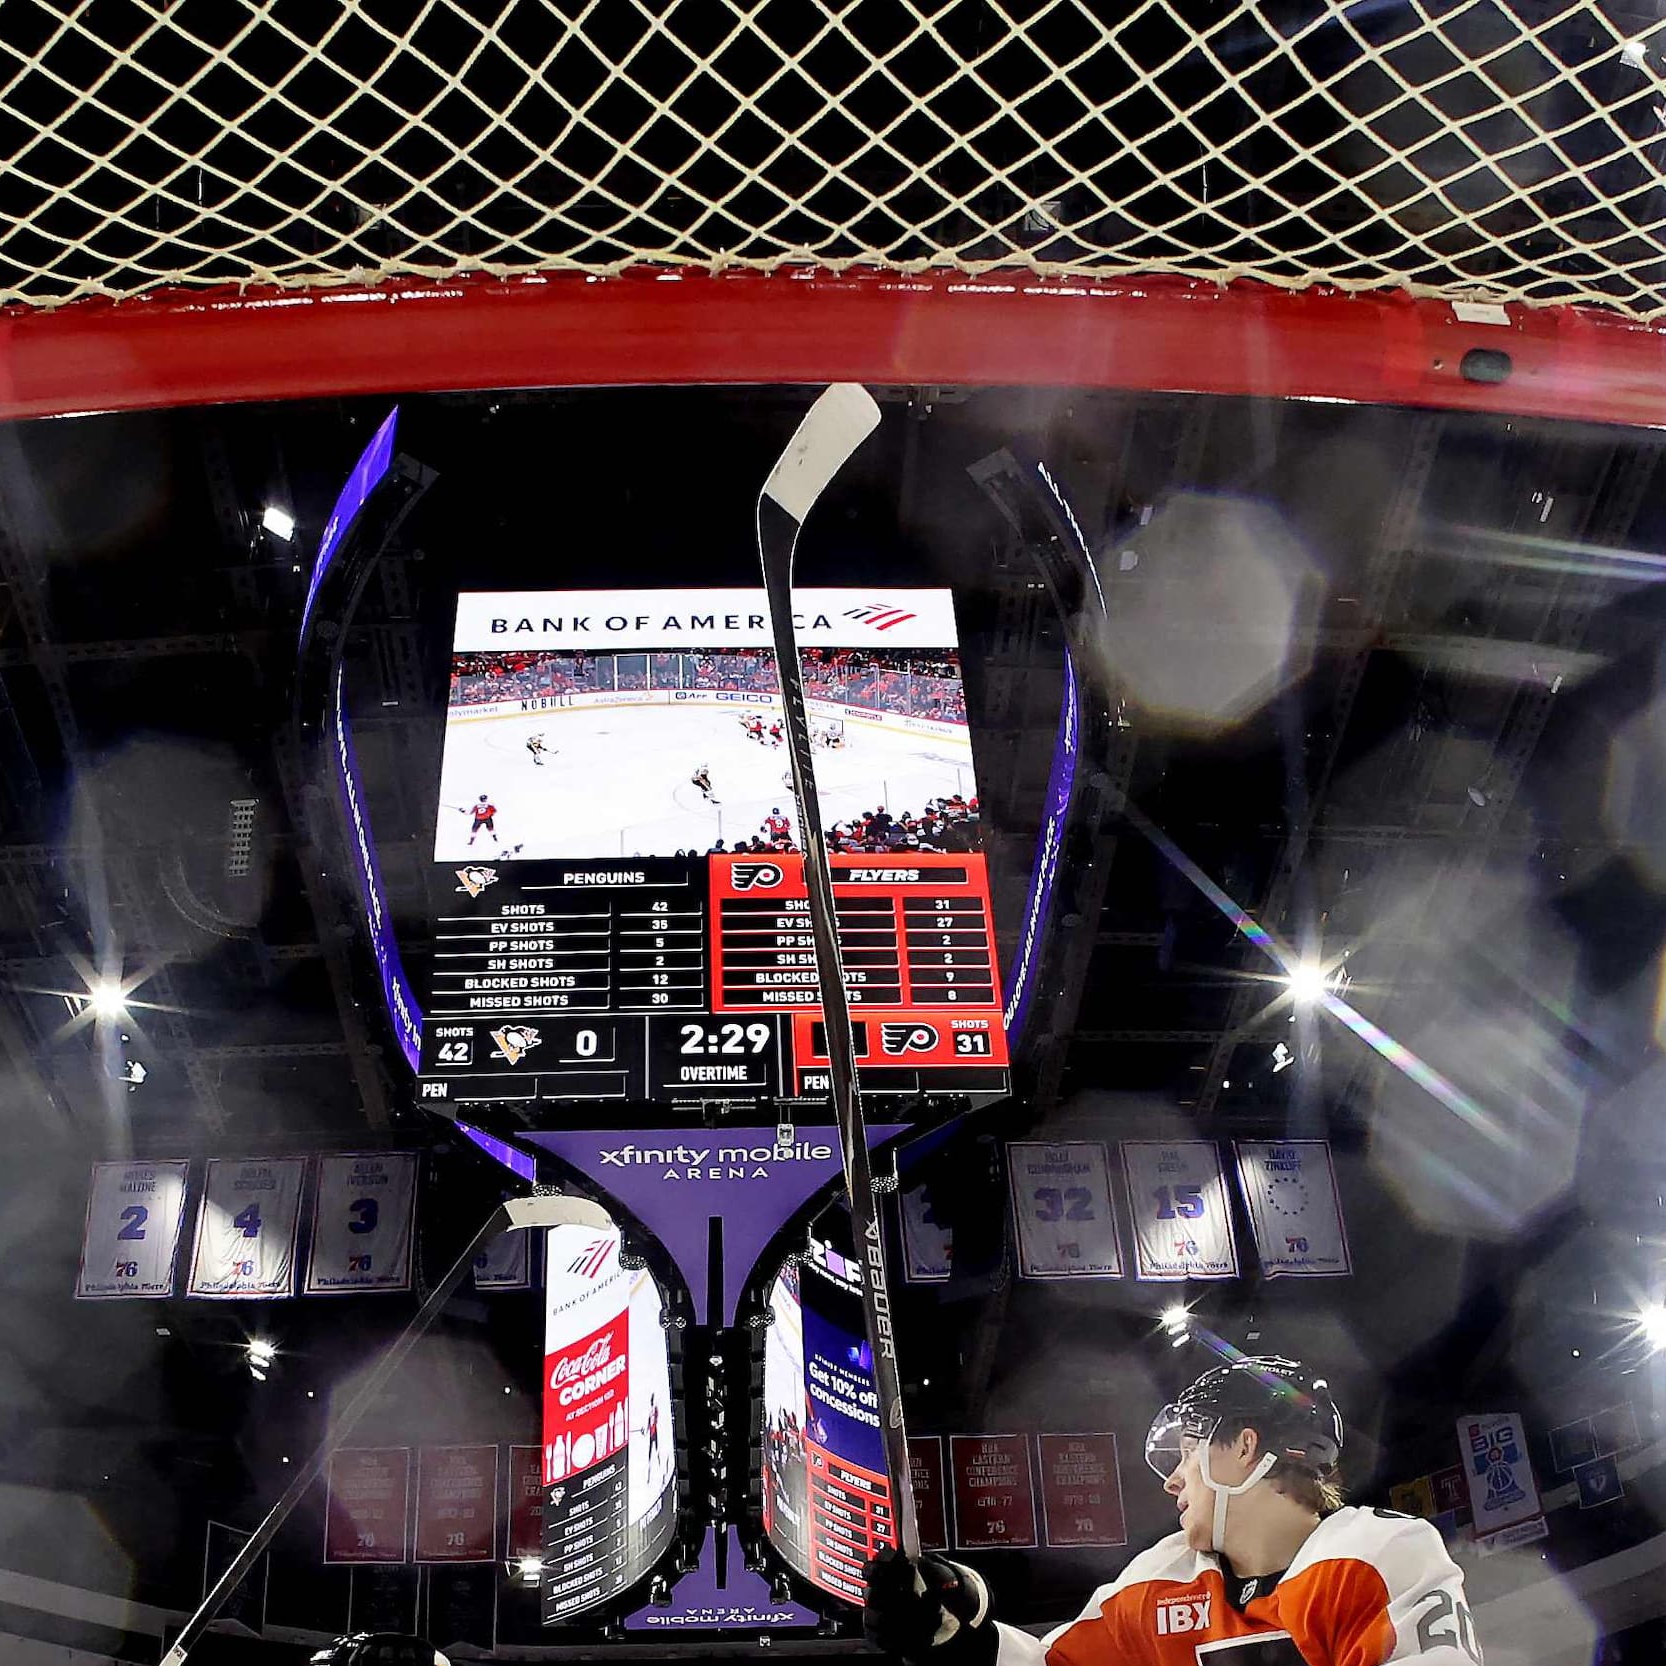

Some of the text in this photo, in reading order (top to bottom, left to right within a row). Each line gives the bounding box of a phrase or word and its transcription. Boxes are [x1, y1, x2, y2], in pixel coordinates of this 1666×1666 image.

[490, 614, 832, 634] BANK OF AMERCA
[521, 695, 573, 711] NOBULL
[716, 693, 772, 703] GEICO
[563, 872, 645, 885] PENGUINS
[849, 869, 920, 881] FLYERS
[501, 902, 669, 915] SHOTS 42
[935, 900, 950, 909] 31
[490, 919, 668, 934] EV SHOTS 35
[776, 918, 953, 928] EV 27
[489, 938, 664, 952] PP SHOTS 5
[776, 936, 952, 946] PP 2
[487, 956, 664, 970] SH SHOTS 2
[776, 954, 797, 964] SH
[944, 954, 953, 963] 2
[464, 974, 668, 989] BLOCKED SHOTS 12
[755, 972, 954, 983] BLOCKED 9
[470, 993, 668, 1008] MISSED SHOTS 30
[762, 991, 957, 1002] MISSED 8
[951, 1019, 989, 1029] SHOTS
[435, 1027, 474, 1038] SHOTS
[680, 1023, 984, 1054] 2:29 31
[438, 1030, 597, 1061] 42 0
[680, 1065, 747, 1082] OVERTIME
[422, 1083, 448, 1098] PEN
[804, 1076, 830, 1090] PEN
[599, 1142, 832, 1167] xfinity mobile
[663, 1167, 769, 1179] ARENA
[1033, 1187, 1095, 1222] 32
[1152, 1185, 1205, 1220] 15
[117, 1205, 149, 1240] 2
[233, 1203, 262, 1238] 4
[348, 1198, 379, 1233] 3
[1174, 1239, 1198, 1256] 76
[115, 1260, 138, 1277] 76
[234, 1260, 254, 1276] 76
[347, 1254, 372, 1272] 76
[552, 1299, 579, 1316] BANK
[866, 1244, 895, 1359] BAUER
[550, 1330, 614, 1390] Coca-Cola
[559, 1354, 627, 1406] CORNER
[808, 1361, 879, 1409] Get 10% off
[809, 1383, 882, 1428] concessions
[1156, 1600, 1212, 1636] IBX
